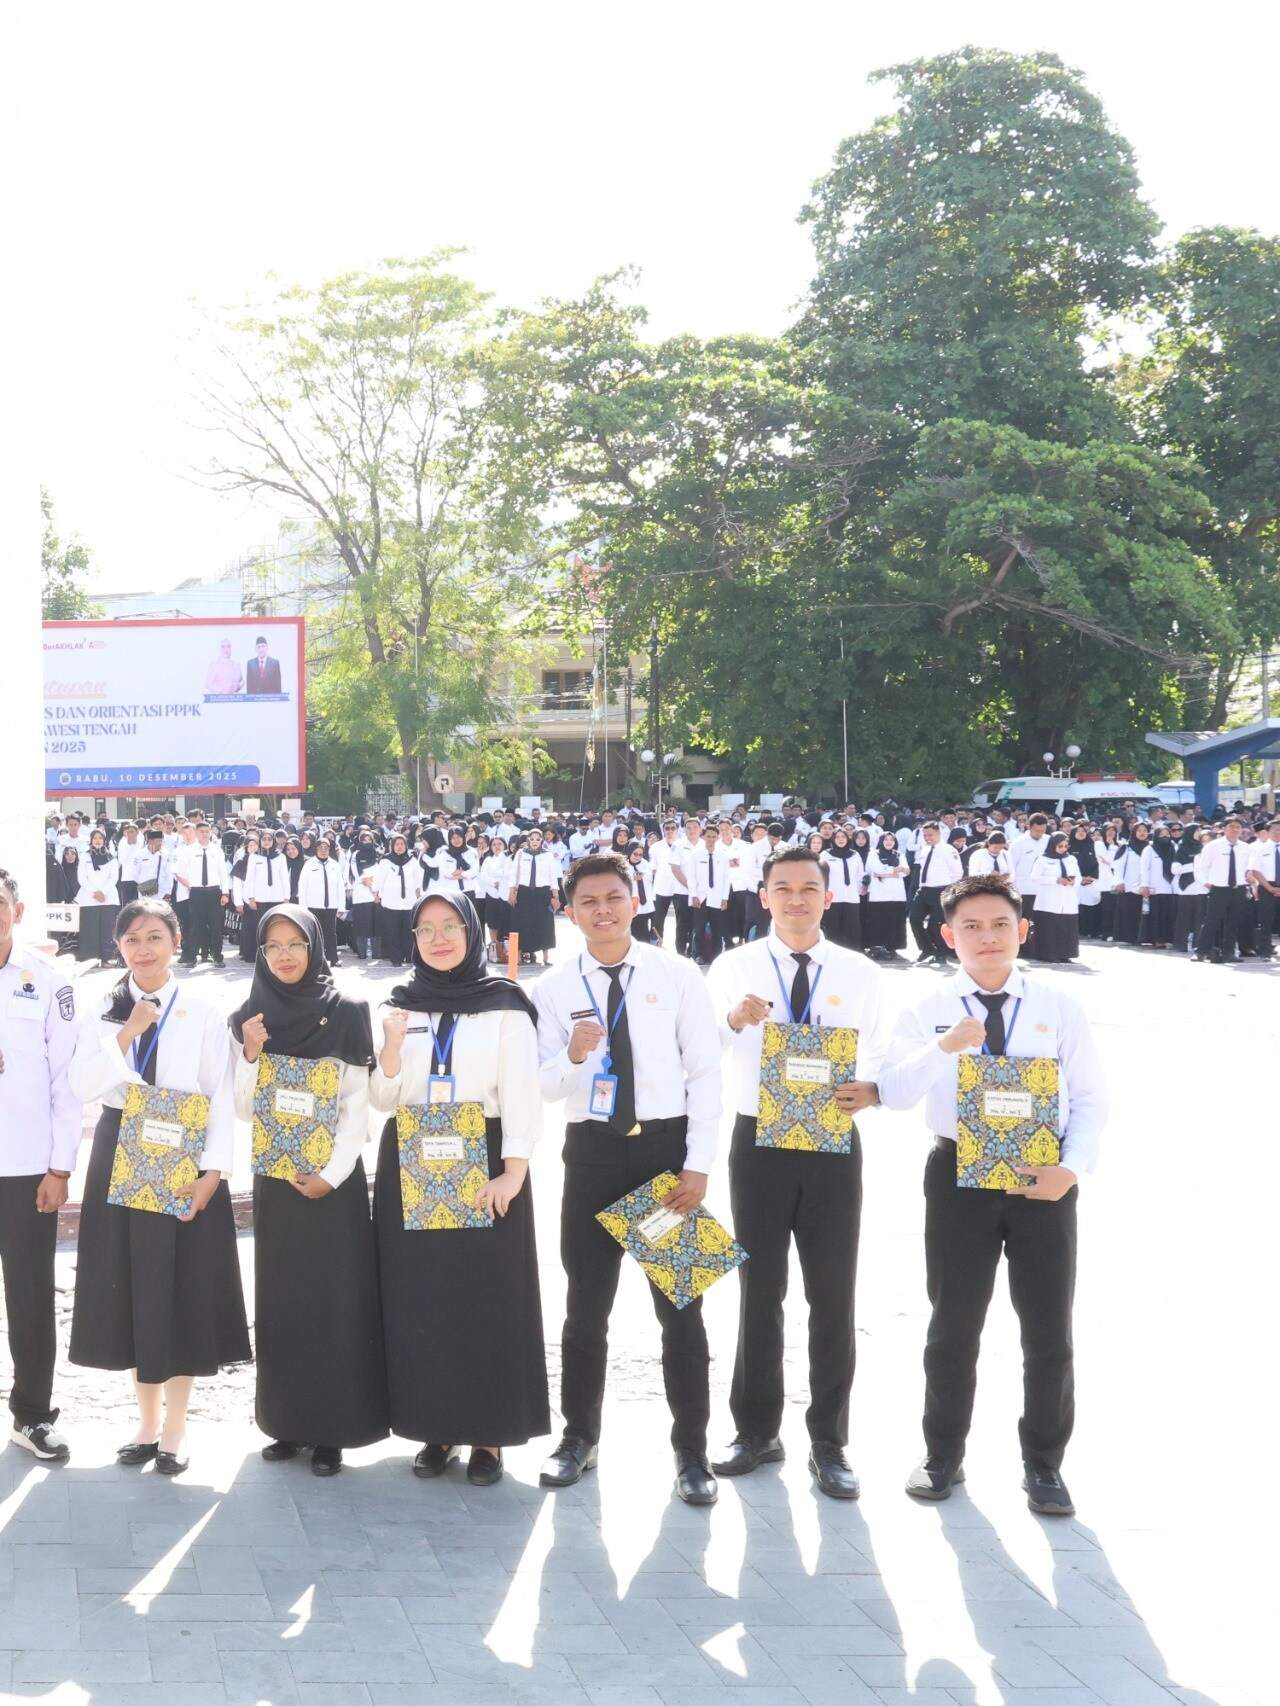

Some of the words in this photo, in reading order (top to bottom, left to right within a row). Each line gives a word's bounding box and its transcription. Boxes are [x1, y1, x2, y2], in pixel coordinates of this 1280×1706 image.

[56, 706, 86, 719] DAN
[88, 704, 162, 719] ORIENTASI
[165, 703, 201, 717] PPPK
[81, 722, 137, 736] TENGAH
[51, 741, 87, 753] 2025
[76, 774, 113, 784] RABU,
[120, 773, 132, 782] 10
[138, 772, 202, 782] DESEMBER
[208, 772, 237, 781] 2025
[46, 912, 63, 921] PK
